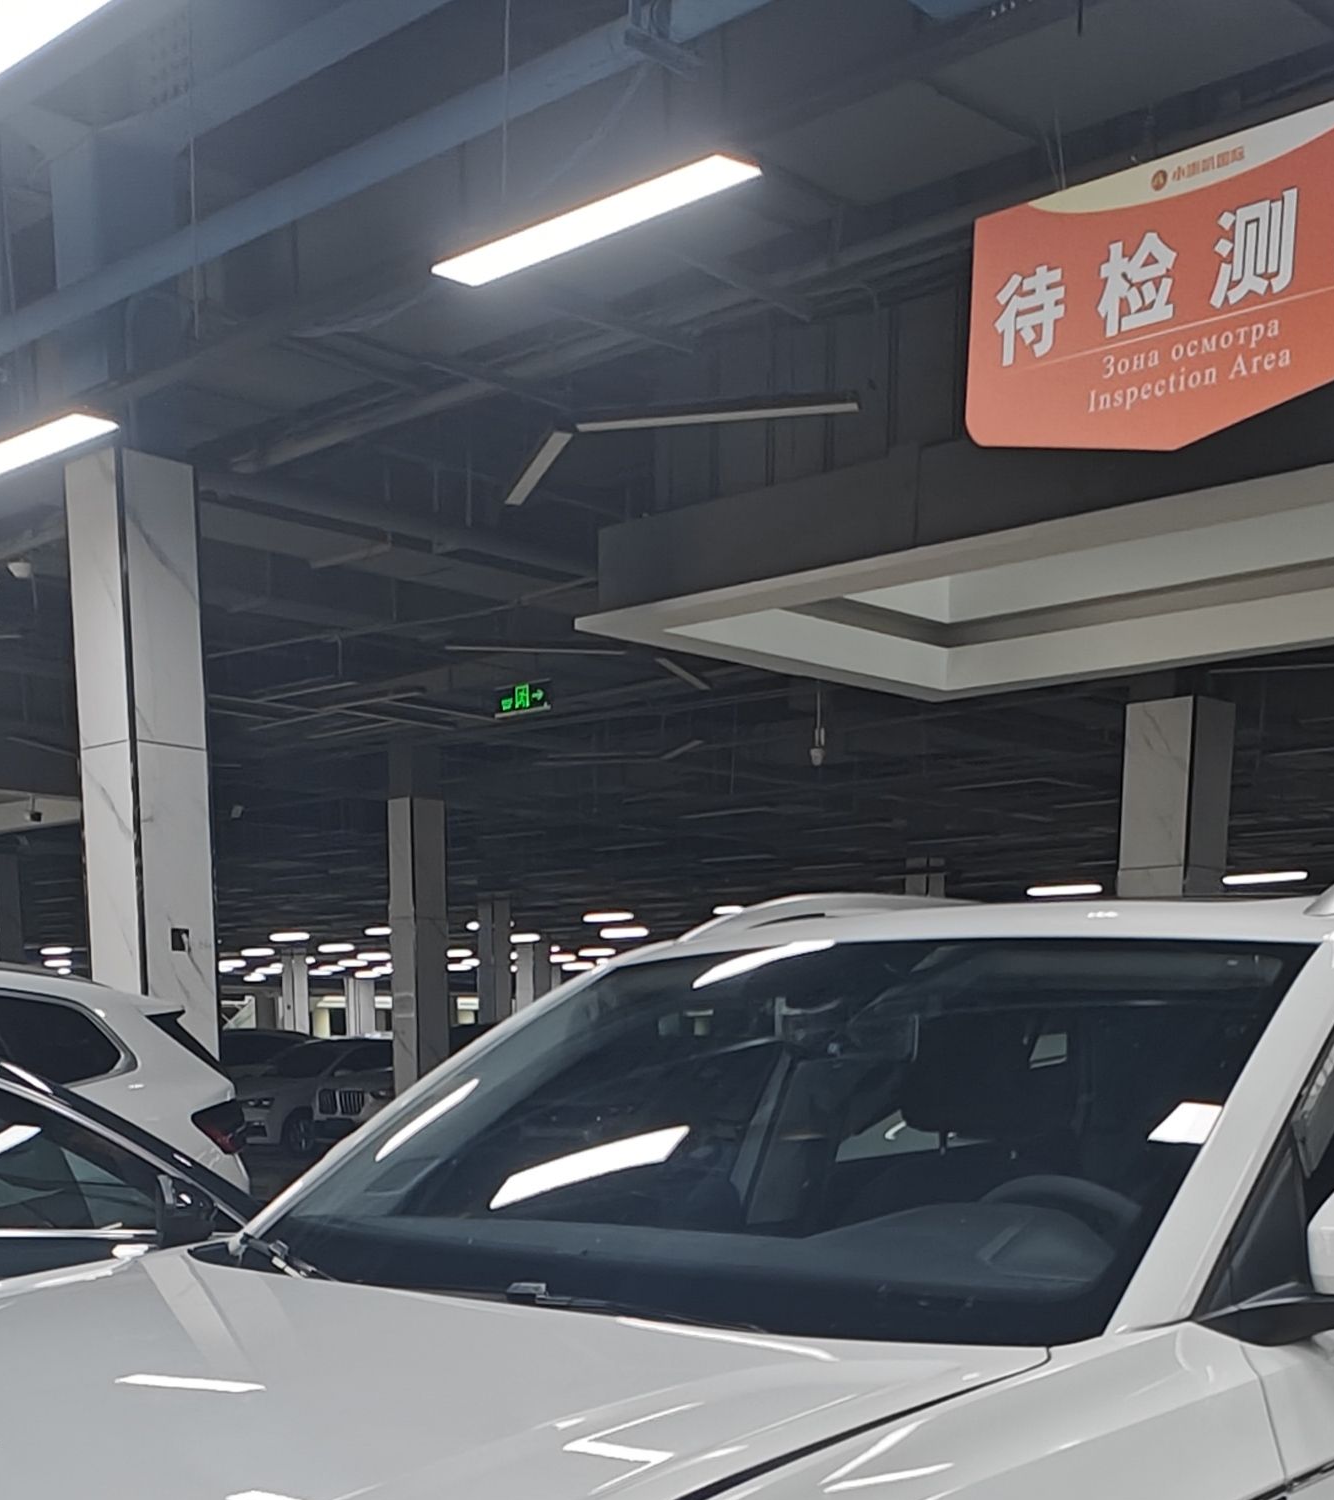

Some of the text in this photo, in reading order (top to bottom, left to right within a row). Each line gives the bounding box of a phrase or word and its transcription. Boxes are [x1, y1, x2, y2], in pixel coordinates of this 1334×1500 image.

[1088, 348, 1292, 413] Inspection Area
[1102, 319, 1280, 380] Зона осмотра
